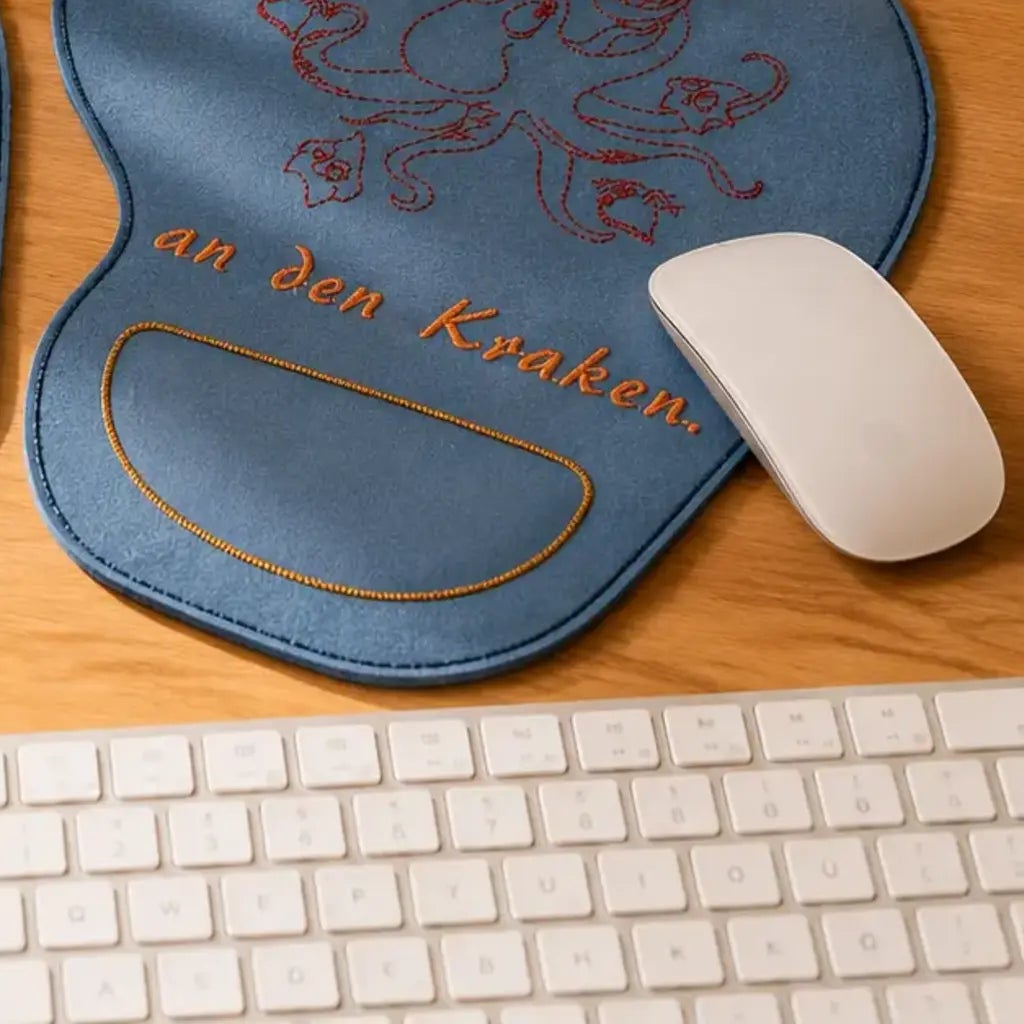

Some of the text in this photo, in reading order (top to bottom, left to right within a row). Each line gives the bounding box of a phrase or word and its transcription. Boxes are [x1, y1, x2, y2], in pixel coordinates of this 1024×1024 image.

[153, 227, 701, 435] an den Kraken.
